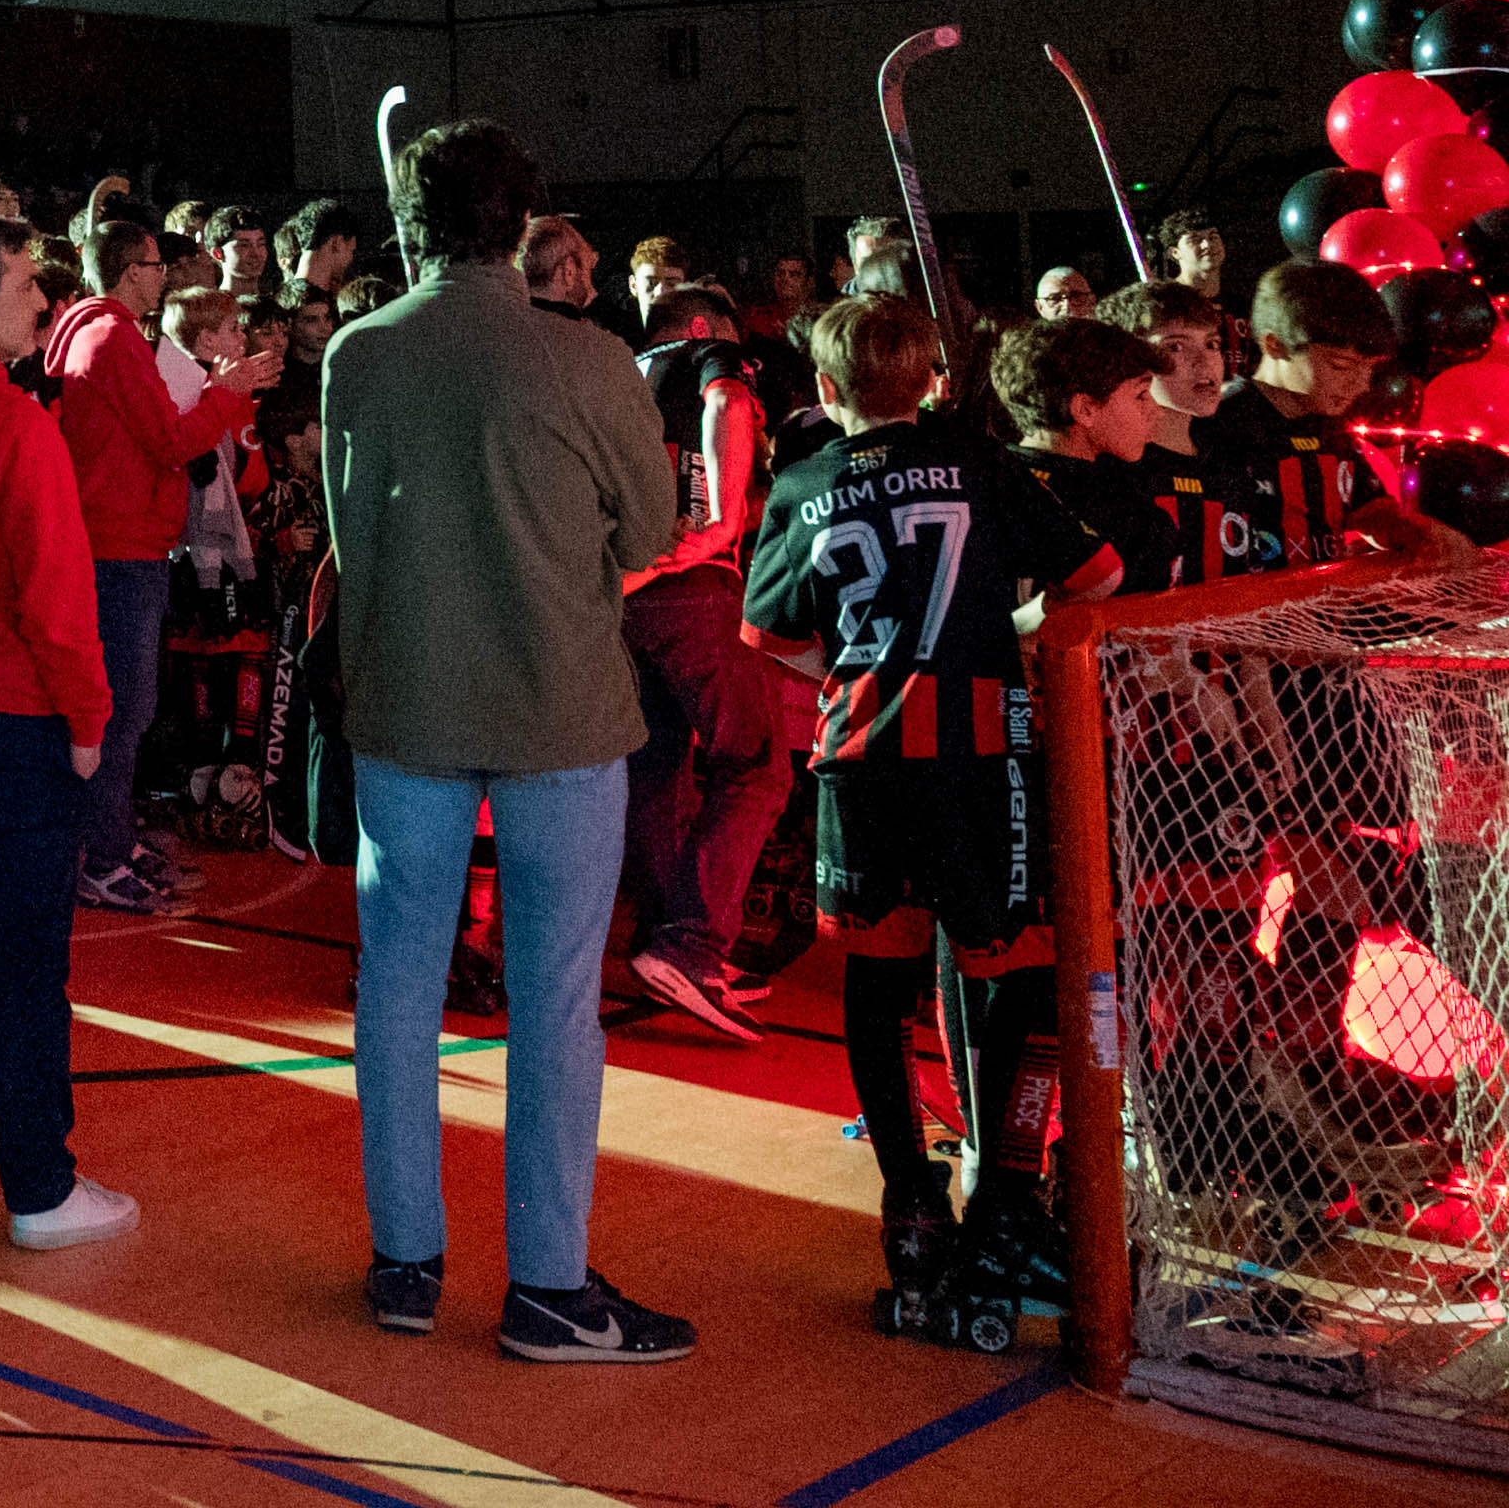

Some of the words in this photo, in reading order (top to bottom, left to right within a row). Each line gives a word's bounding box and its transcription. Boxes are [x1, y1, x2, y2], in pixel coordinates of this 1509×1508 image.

[848, 452, 889, 475] 1967
[800, 479, 877, 526] QUIM
[883, 466, 964, 496] ORRI
[810, 500, 972, 668] 27
[1008, 706, 1034, 746] Sant
